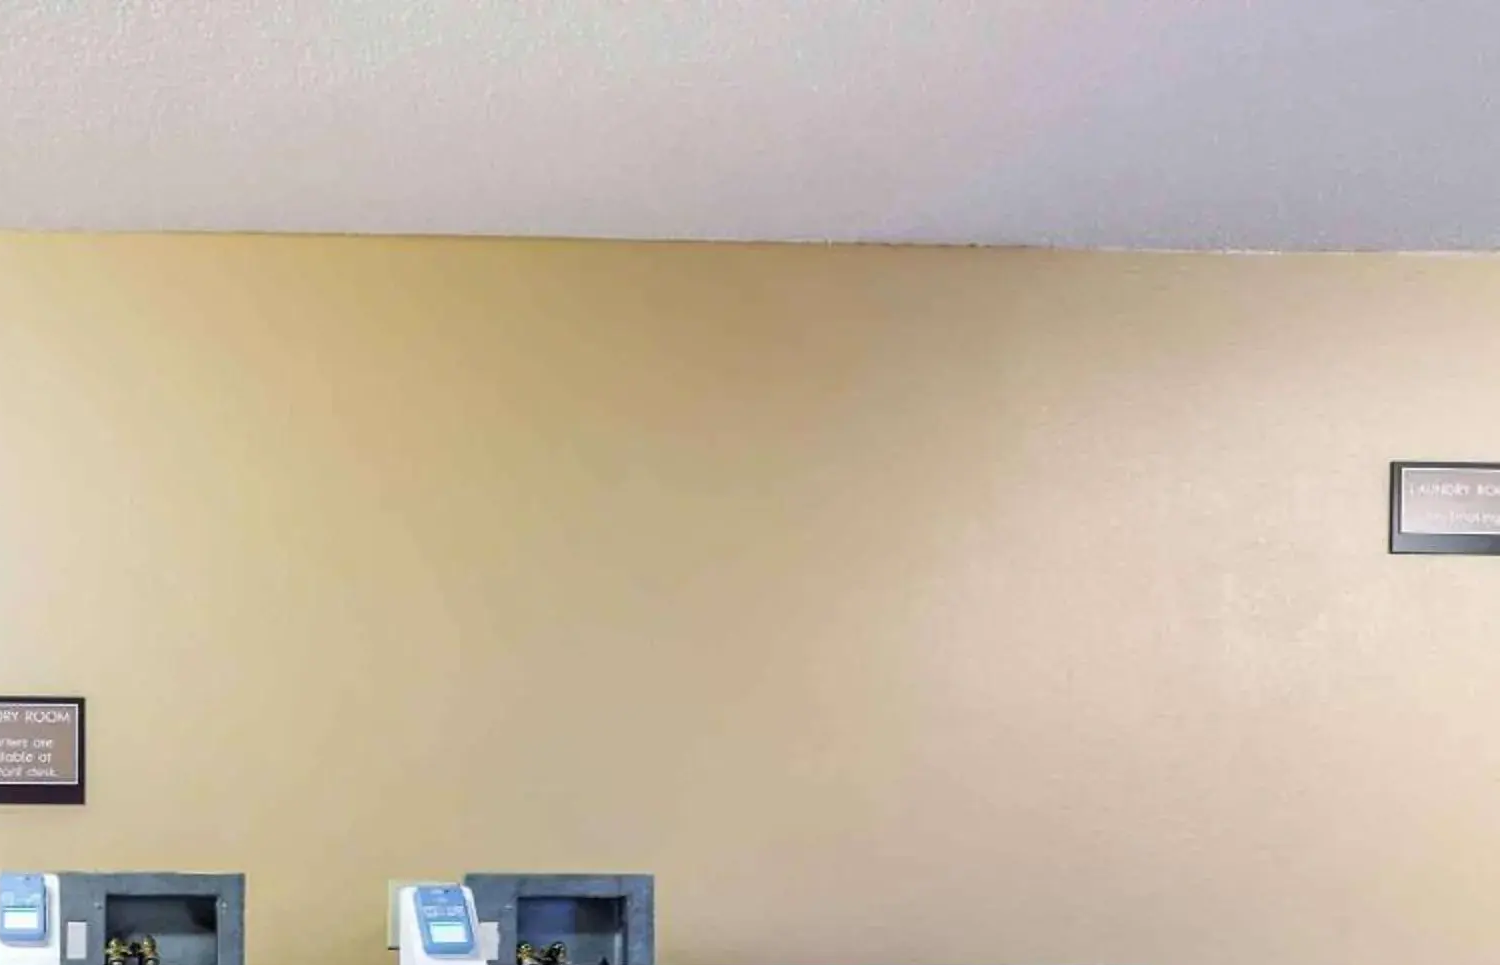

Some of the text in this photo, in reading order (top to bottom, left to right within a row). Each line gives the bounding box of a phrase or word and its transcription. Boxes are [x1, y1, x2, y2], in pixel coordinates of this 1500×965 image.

[25, 709, 71, 724] ROOM
[33, 738, 53, 749] are
[37, 751, 52, 764] at
